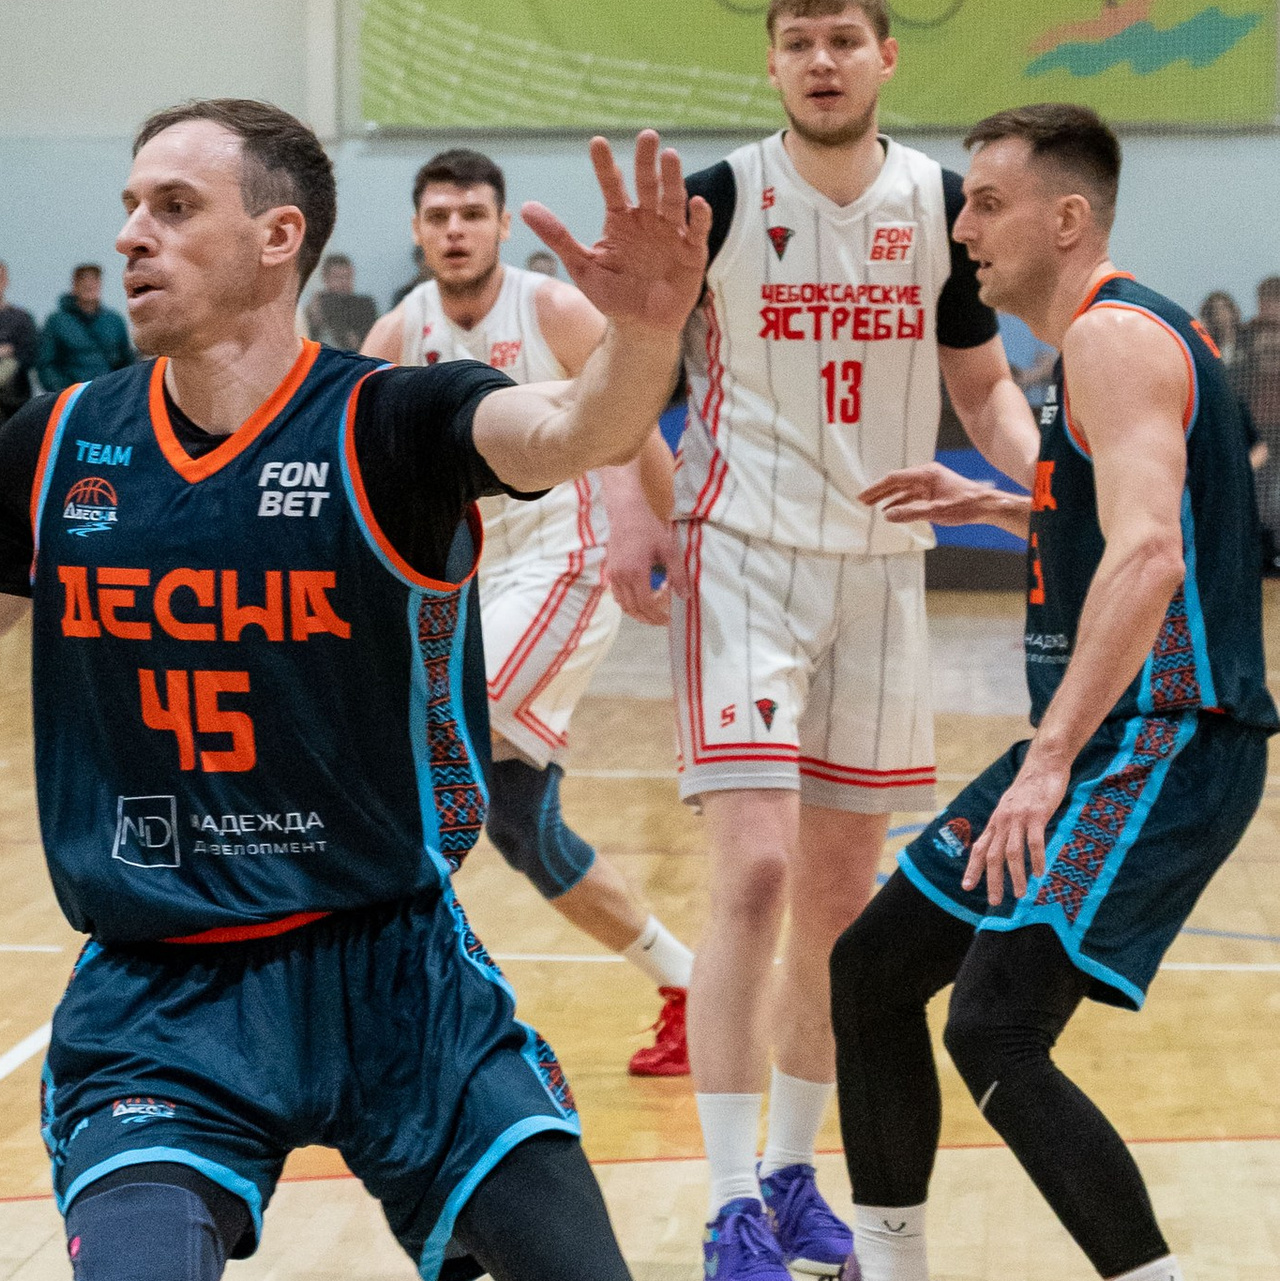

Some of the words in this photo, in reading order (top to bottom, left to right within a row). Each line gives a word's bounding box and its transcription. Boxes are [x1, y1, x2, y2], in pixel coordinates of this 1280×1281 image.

[873, 227, 913, 244] FON
[869, 245, 910, 261] BET
[761, 284, 921, 305] ЧЕБОКСАРСКИЕ
[759, 306, 925, 340] ЯСТРЕБЫ
[821, 360, 862, 424] 13
[75, 439, 133, 467] TEAM
[258, 462, 330, 488] FON
[257, 491, 331, 517] BET
[57, 565, 352, 642] ДЕСНА
[137, 668, 257, 773] 45
